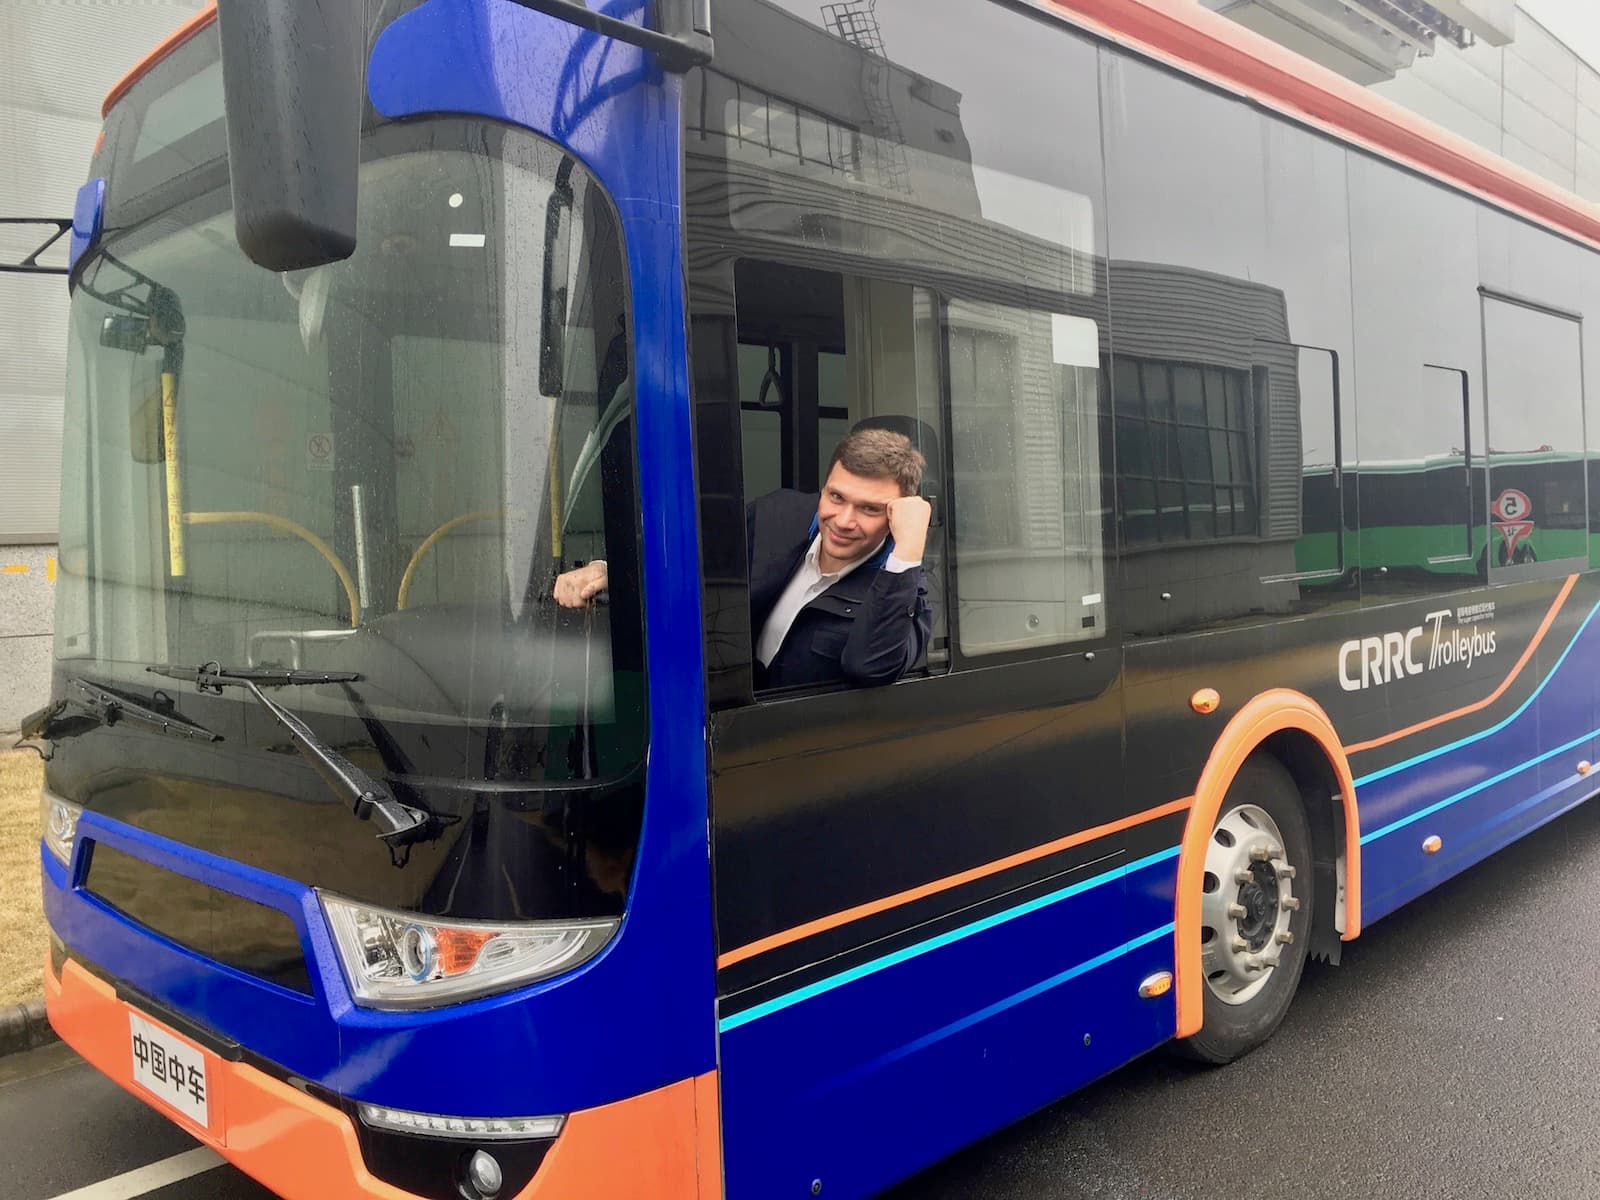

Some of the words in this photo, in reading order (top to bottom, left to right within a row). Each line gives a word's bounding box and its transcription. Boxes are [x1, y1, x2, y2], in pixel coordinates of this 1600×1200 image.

[1338, 626, 1424, 692] CRRC
[1425, 609, 1496, 670] Trolleybus
[133, 1033, 205, 1105] 中国中车
